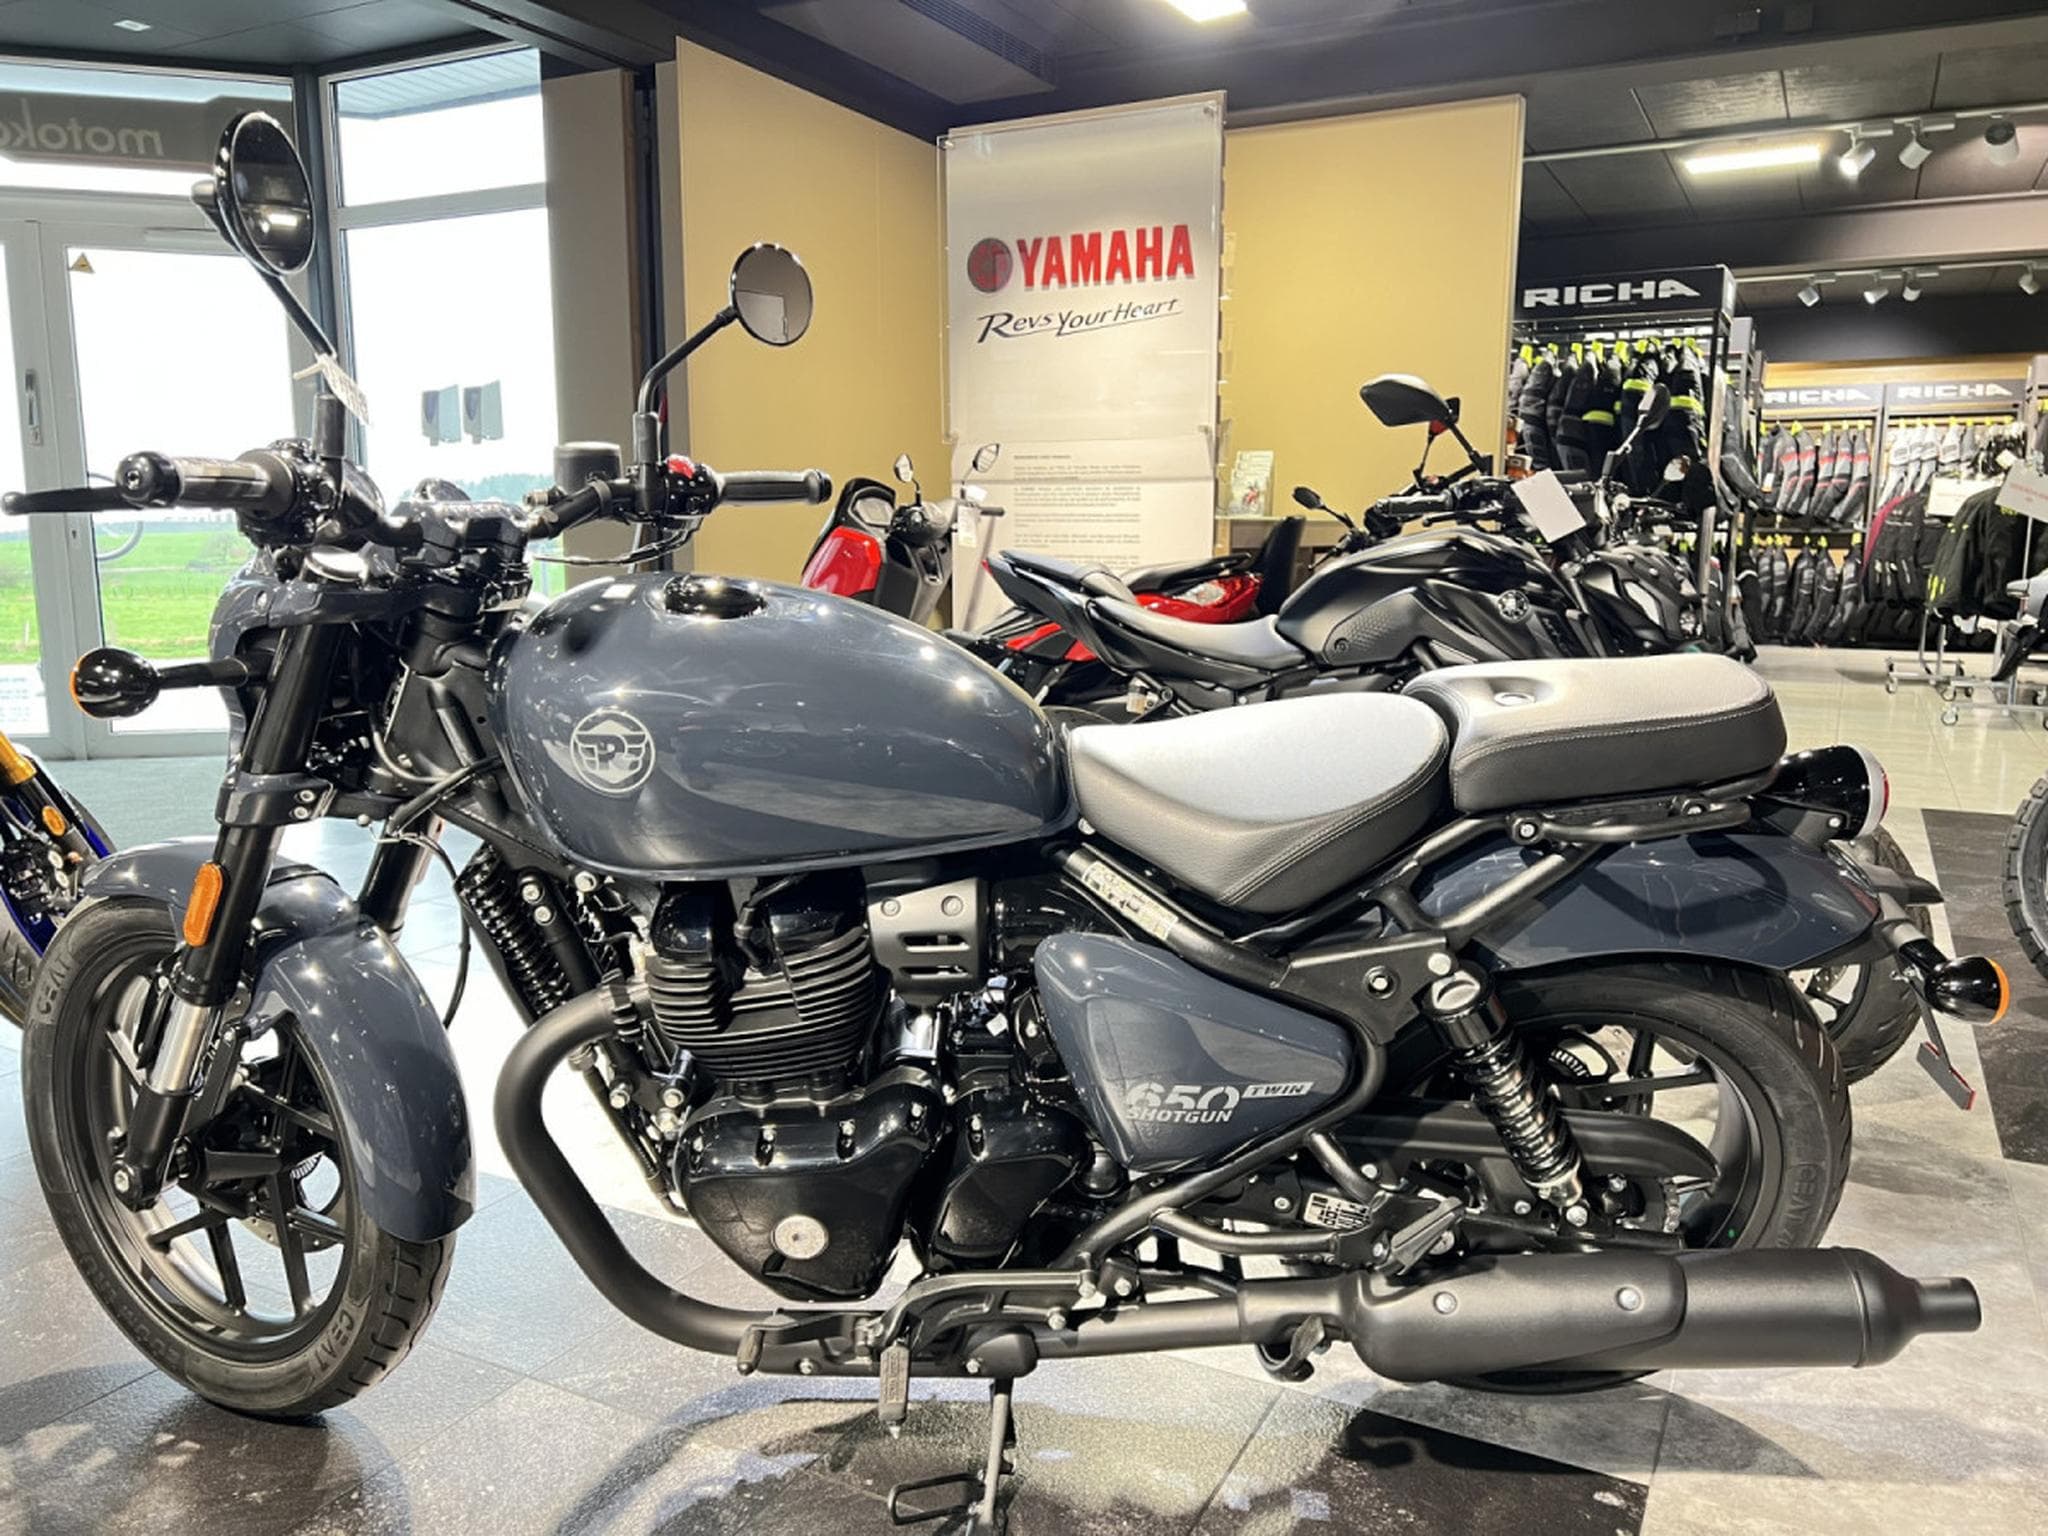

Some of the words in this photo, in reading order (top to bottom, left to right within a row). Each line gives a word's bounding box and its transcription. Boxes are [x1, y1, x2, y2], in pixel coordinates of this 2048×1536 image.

[1016, 224, 1195, 289] YAMAHA
[1523, 279, 1700, 308] RICHA
[977, 312, 1052, 343] Revs
[1055, 310, 1113, 337] Your
[1113, 299, 1179, 322] Heart
[1763, 388, 1872, 404] RICHA
[1897, 383, 2013, 398] RICHA
[1126, 1081, 1240, 1109] 650
[1251, 1084, 1305, 1097] TWIN
[1125, 1106, 1232, 1123] SHOTGUN
[314, 1308, 355, 1372] CEAT
